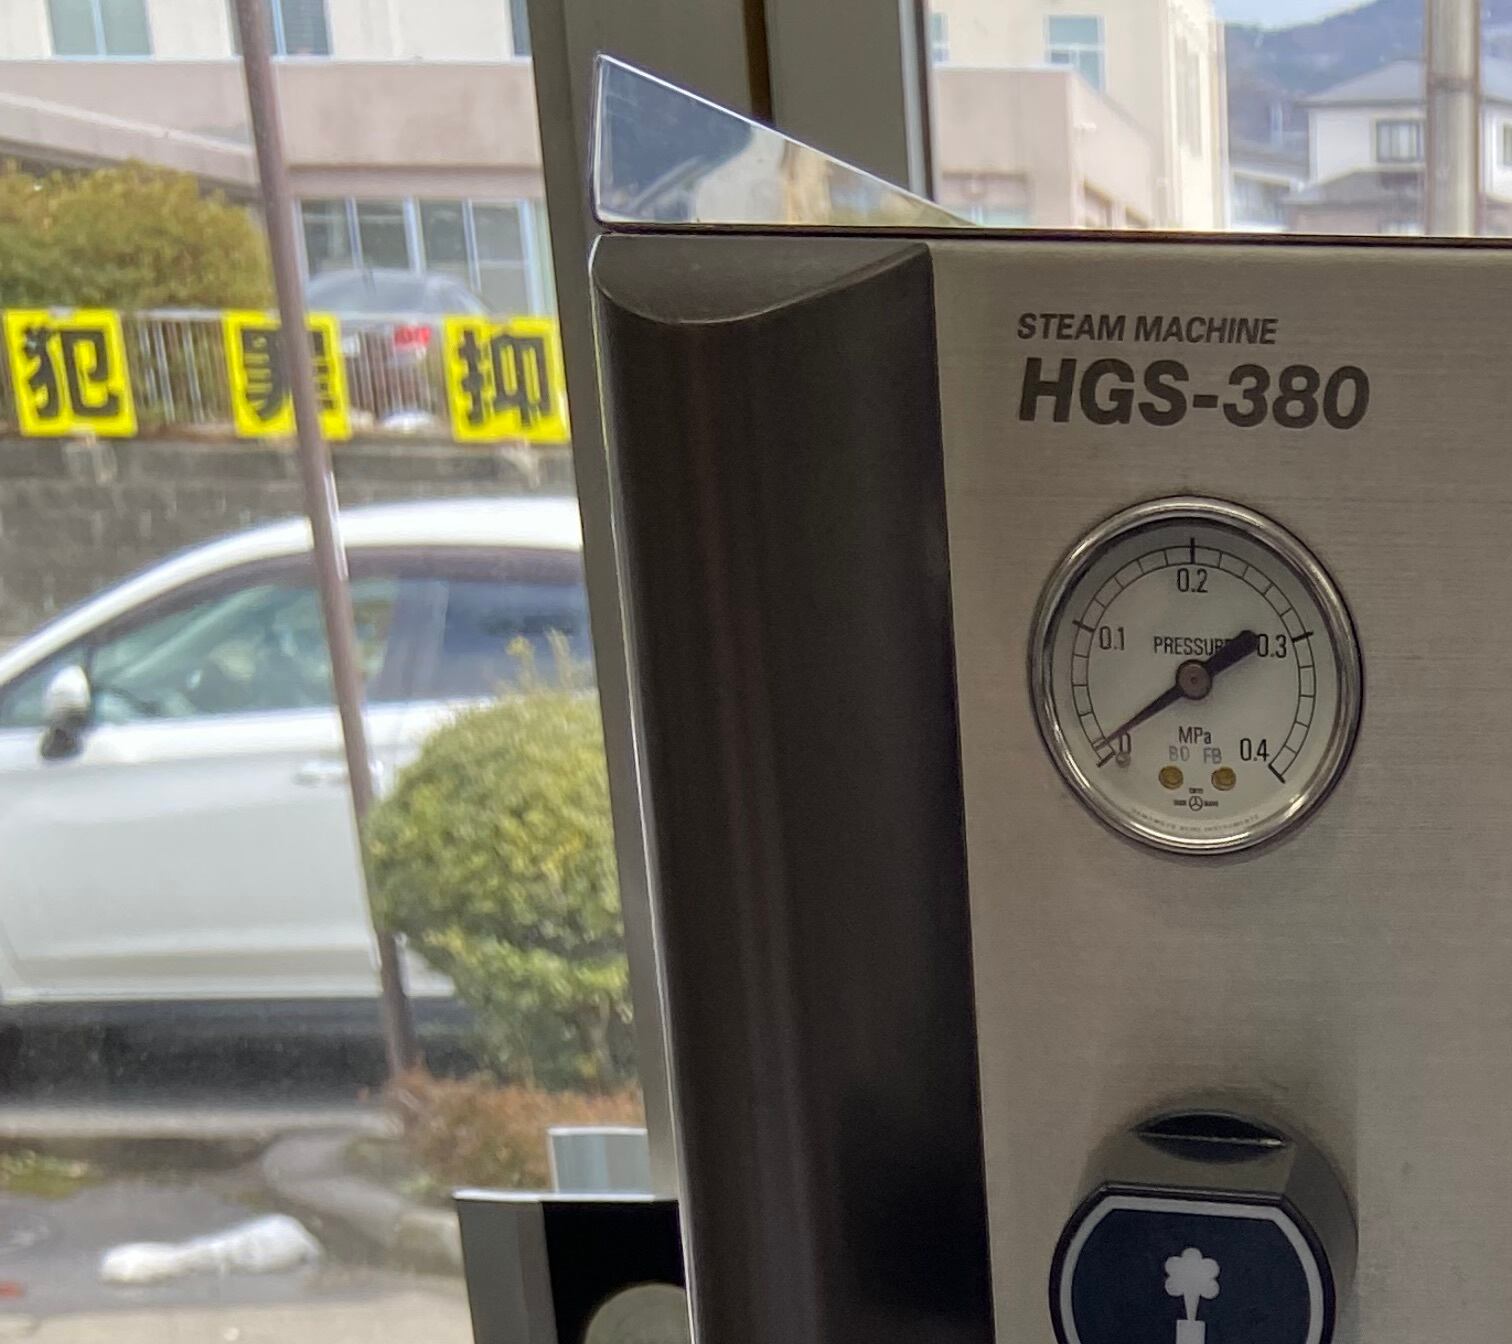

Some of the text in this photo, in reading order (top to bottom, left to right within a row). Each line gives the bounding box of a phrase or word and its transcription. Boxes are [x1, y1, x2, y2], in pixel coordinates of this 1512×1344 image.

[1017, 312, 1279, 345] STEAM MACHINE
[1018, 357, 1371, 430] HGS-380
[1177, 568, 1208, 593] 0.2
[1099, 626, 1125, 651] 0.1
[1153, 636, 1233, 656] PRESSUR
[1257, 634, 1288, 658] 0.3
[1178, 726, 1212, 744] MPa
[1240, 737, 1270, 762] 0.4
